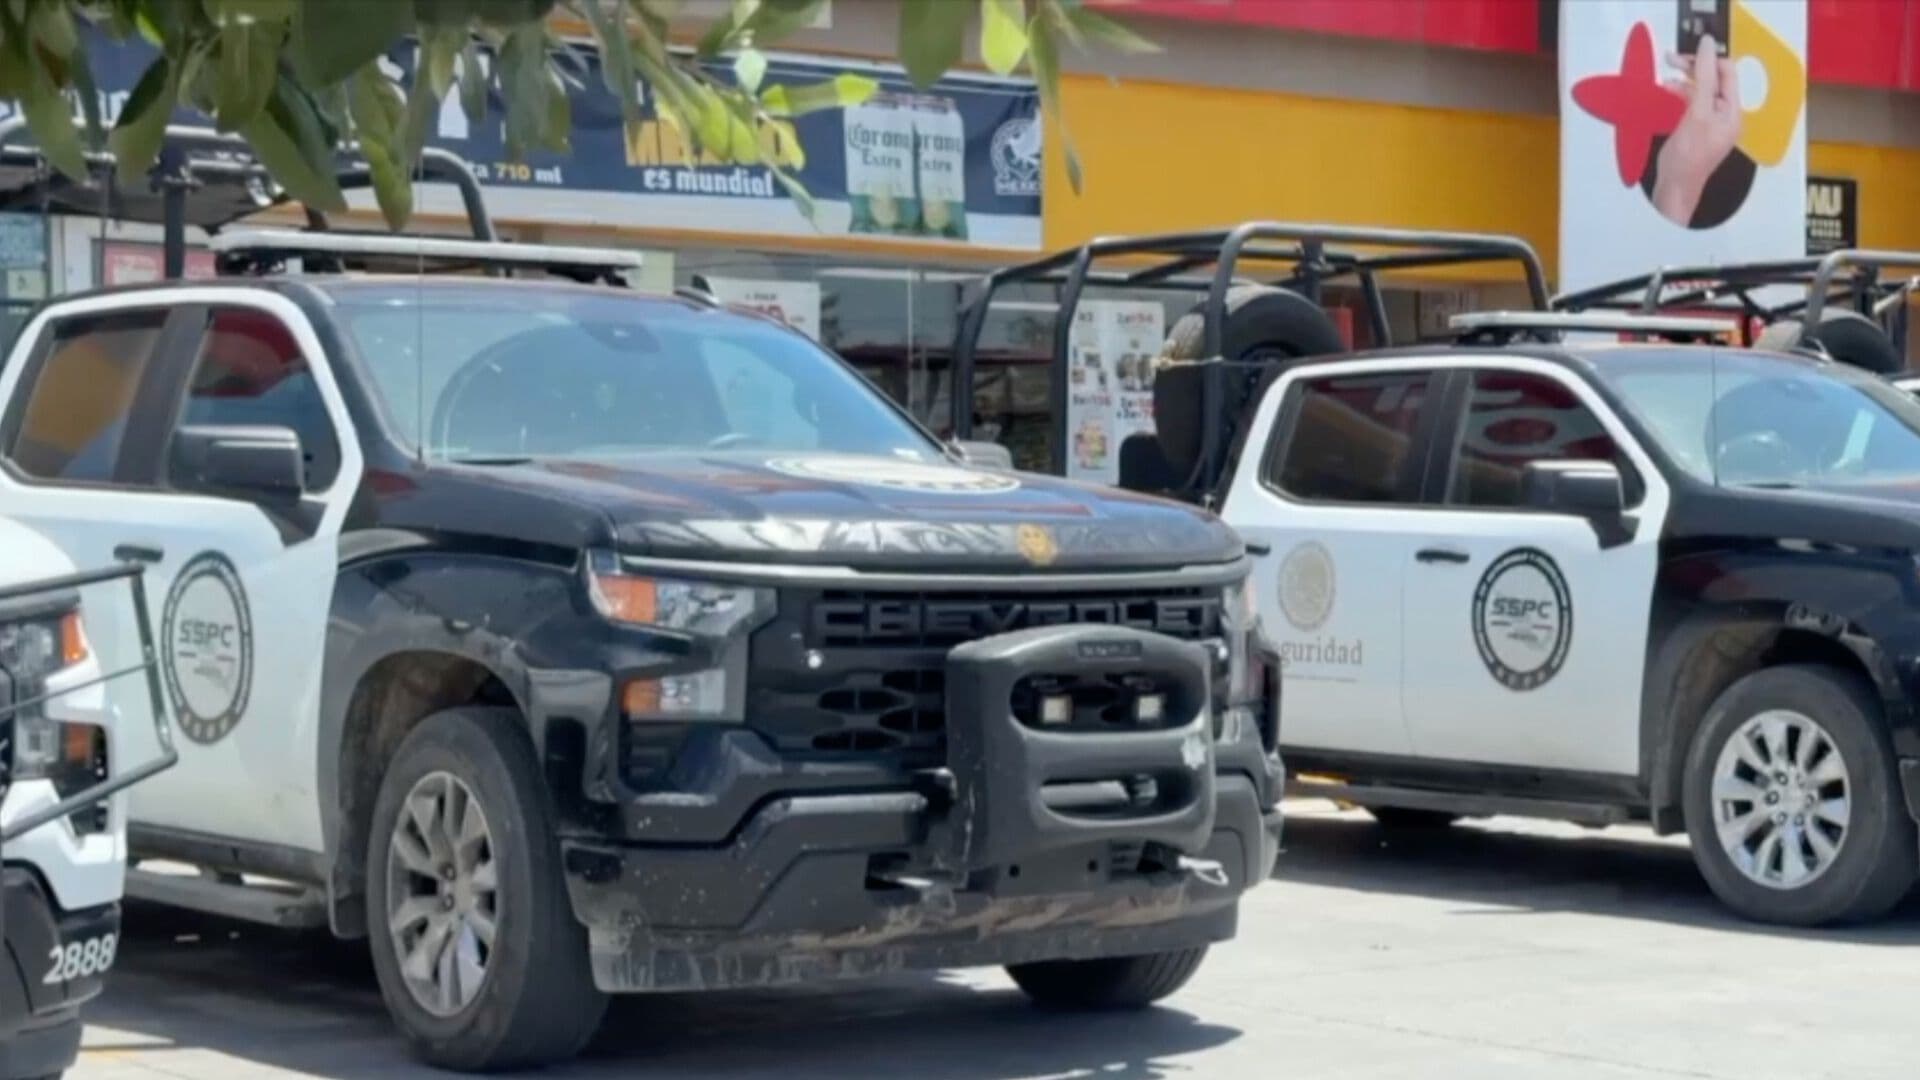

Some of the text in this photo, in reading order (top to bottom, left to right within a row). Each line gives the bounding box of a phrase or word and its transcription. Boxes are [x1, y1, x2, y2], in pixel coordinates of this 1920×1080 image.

[495, 162, 530, 180] 710
[535, 166, 562, 184] ml
[643, 168, 774, 196] es mundial
[1490, 597, 1552, 619] SSPC
[178, 619, 234, 648] SSPC
[42, 932, 117, 985] 2888
